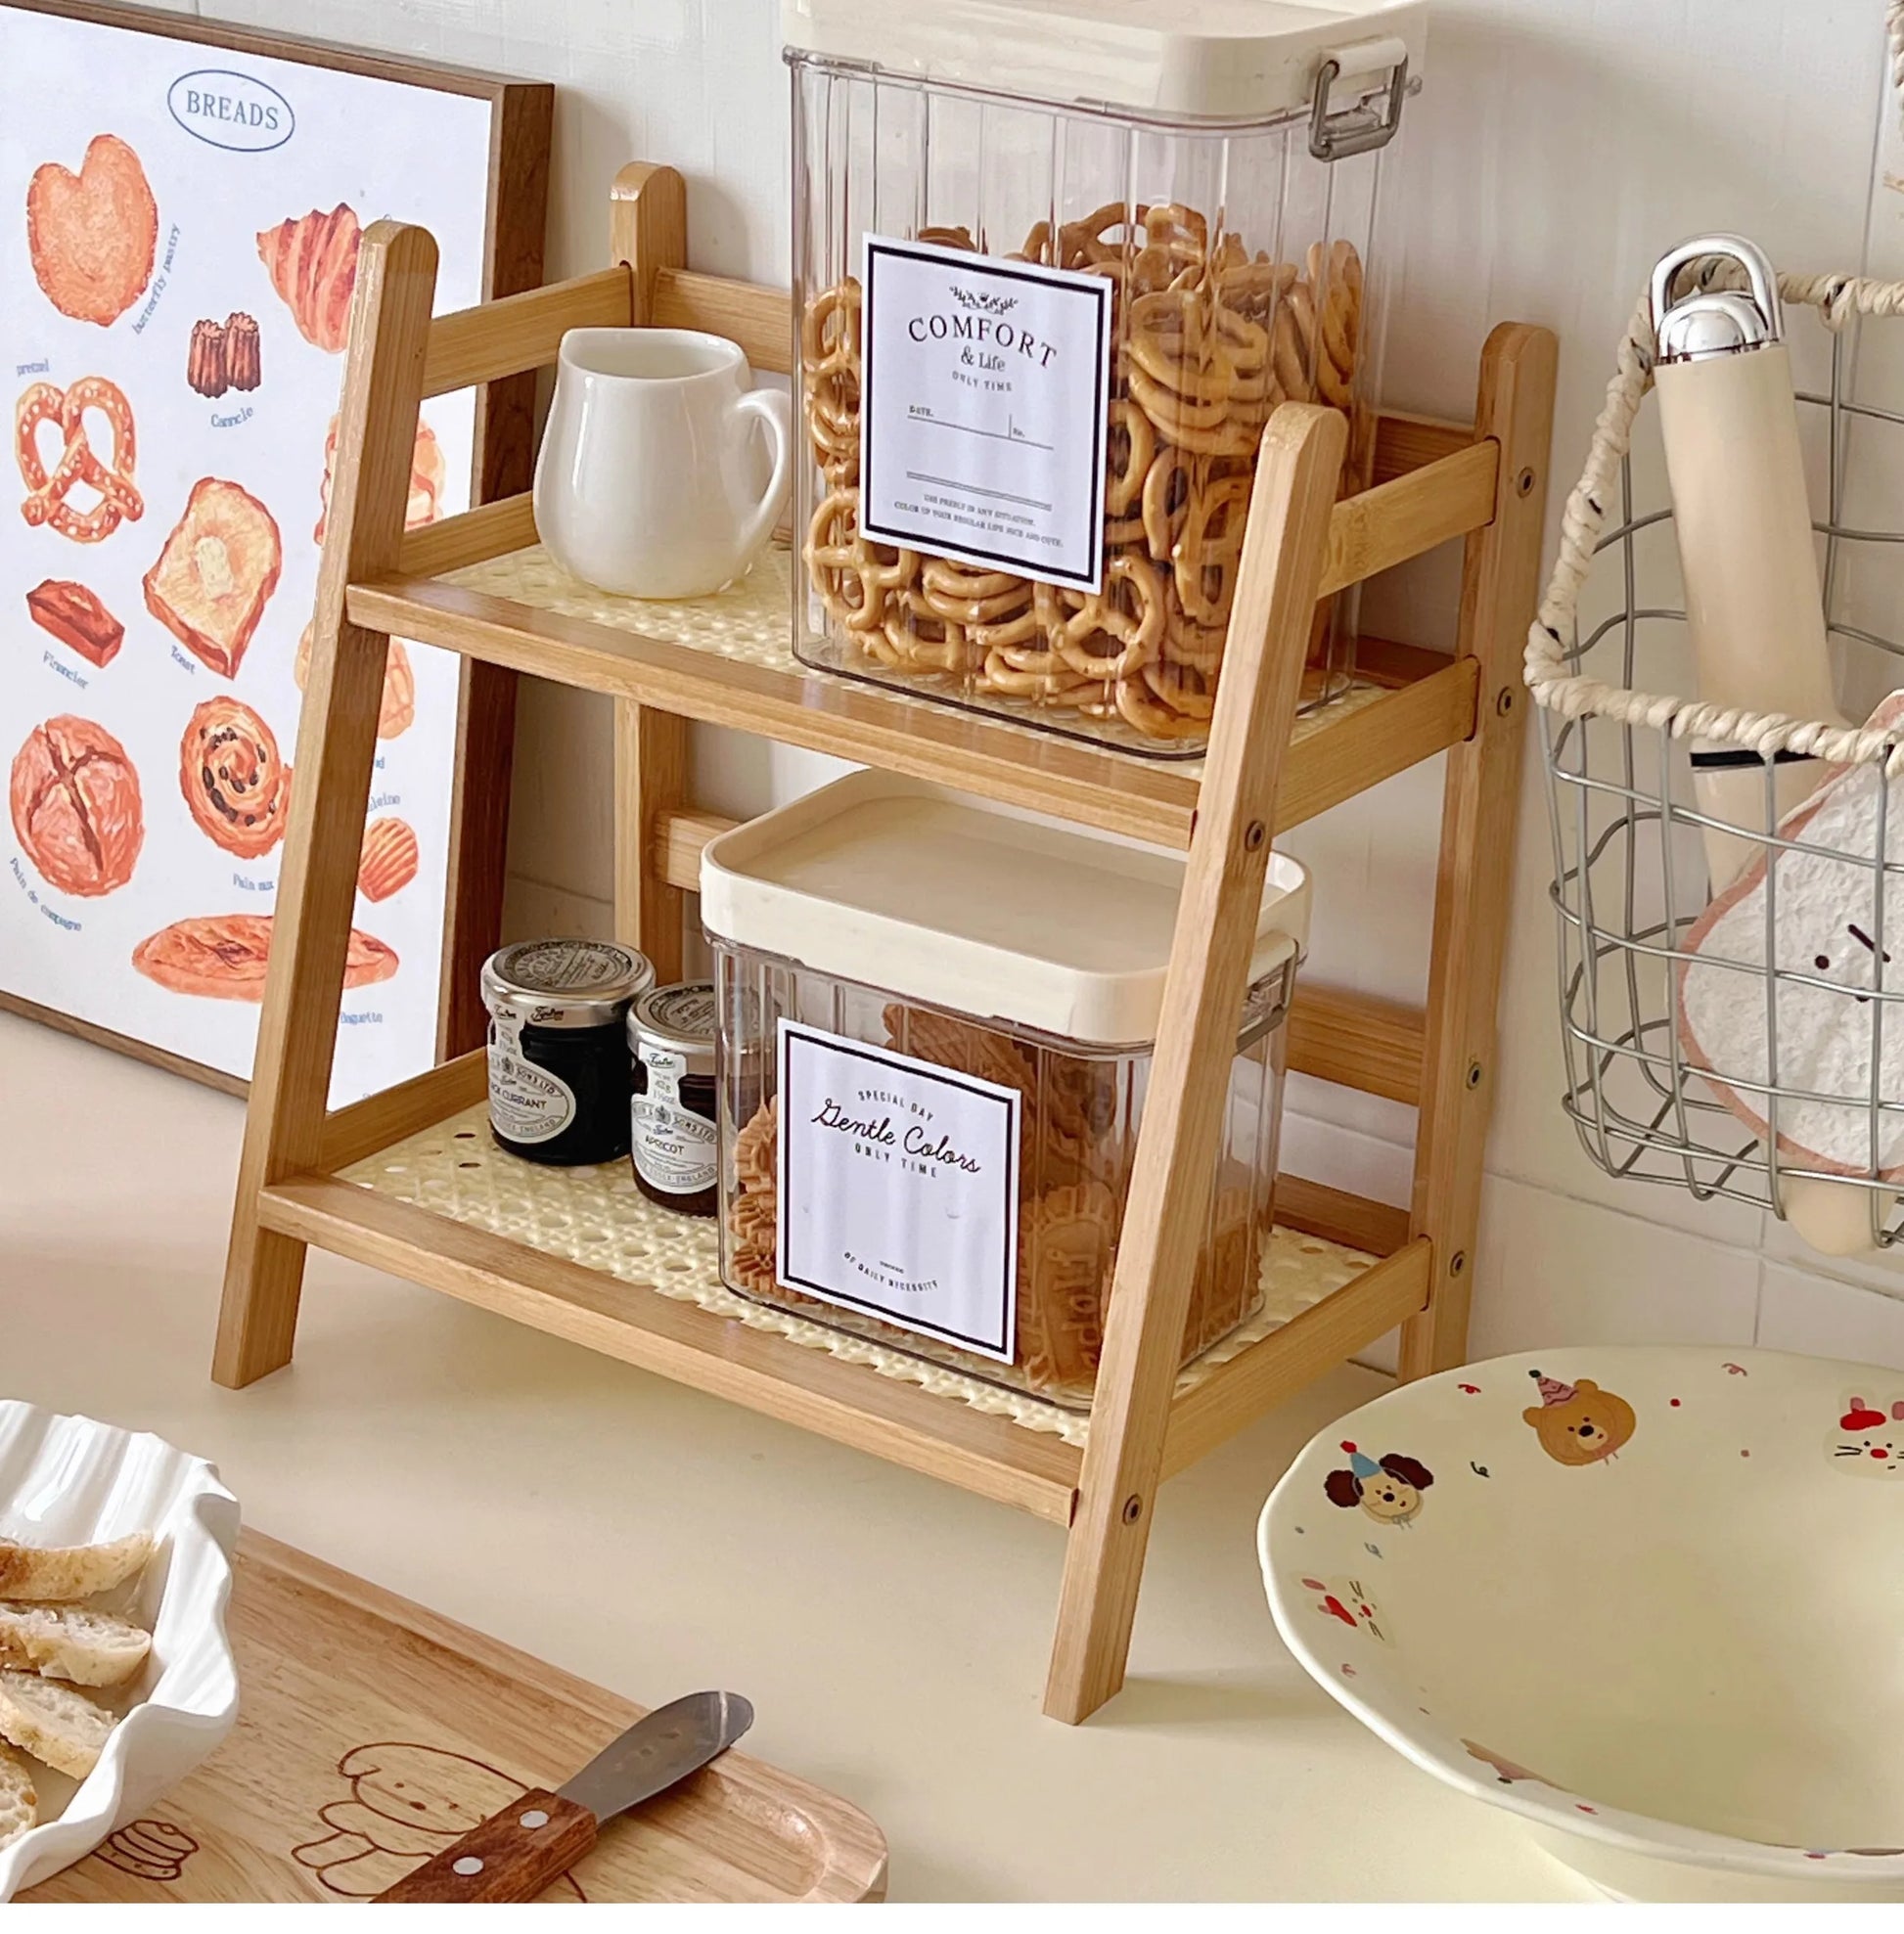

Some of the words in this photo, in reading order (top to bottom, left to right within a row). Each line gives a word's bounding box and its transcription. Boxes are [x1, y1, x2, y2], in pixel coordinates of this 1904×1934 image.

[186, 89, 279, 130] BREADS
[131, 275, 167, 336] butterfly
[908, 314, 1058, 369] COMFORT
[961, 344, 975, 367] &
[978, 351, 1007, 373] Life
[951, 370, 979, 388] ONLY
[983, 380, 1013, 392] TIME
[893, 500, 919, 514] COLOR
[502, 1089, 548, 1110] CURRANT
[858, 1090, 905, 1108] SPECIAL
[910, 1102, 934, 1122] DAY
[810, 1097, 896, 1147] Gentle
[903, 1125, 981, 1174] Colors
[854, 1142, 890, 1164] ONLY
[900, 1156, 937, 1179] TIME
[857, 1263, 885, 1283] DAILY
